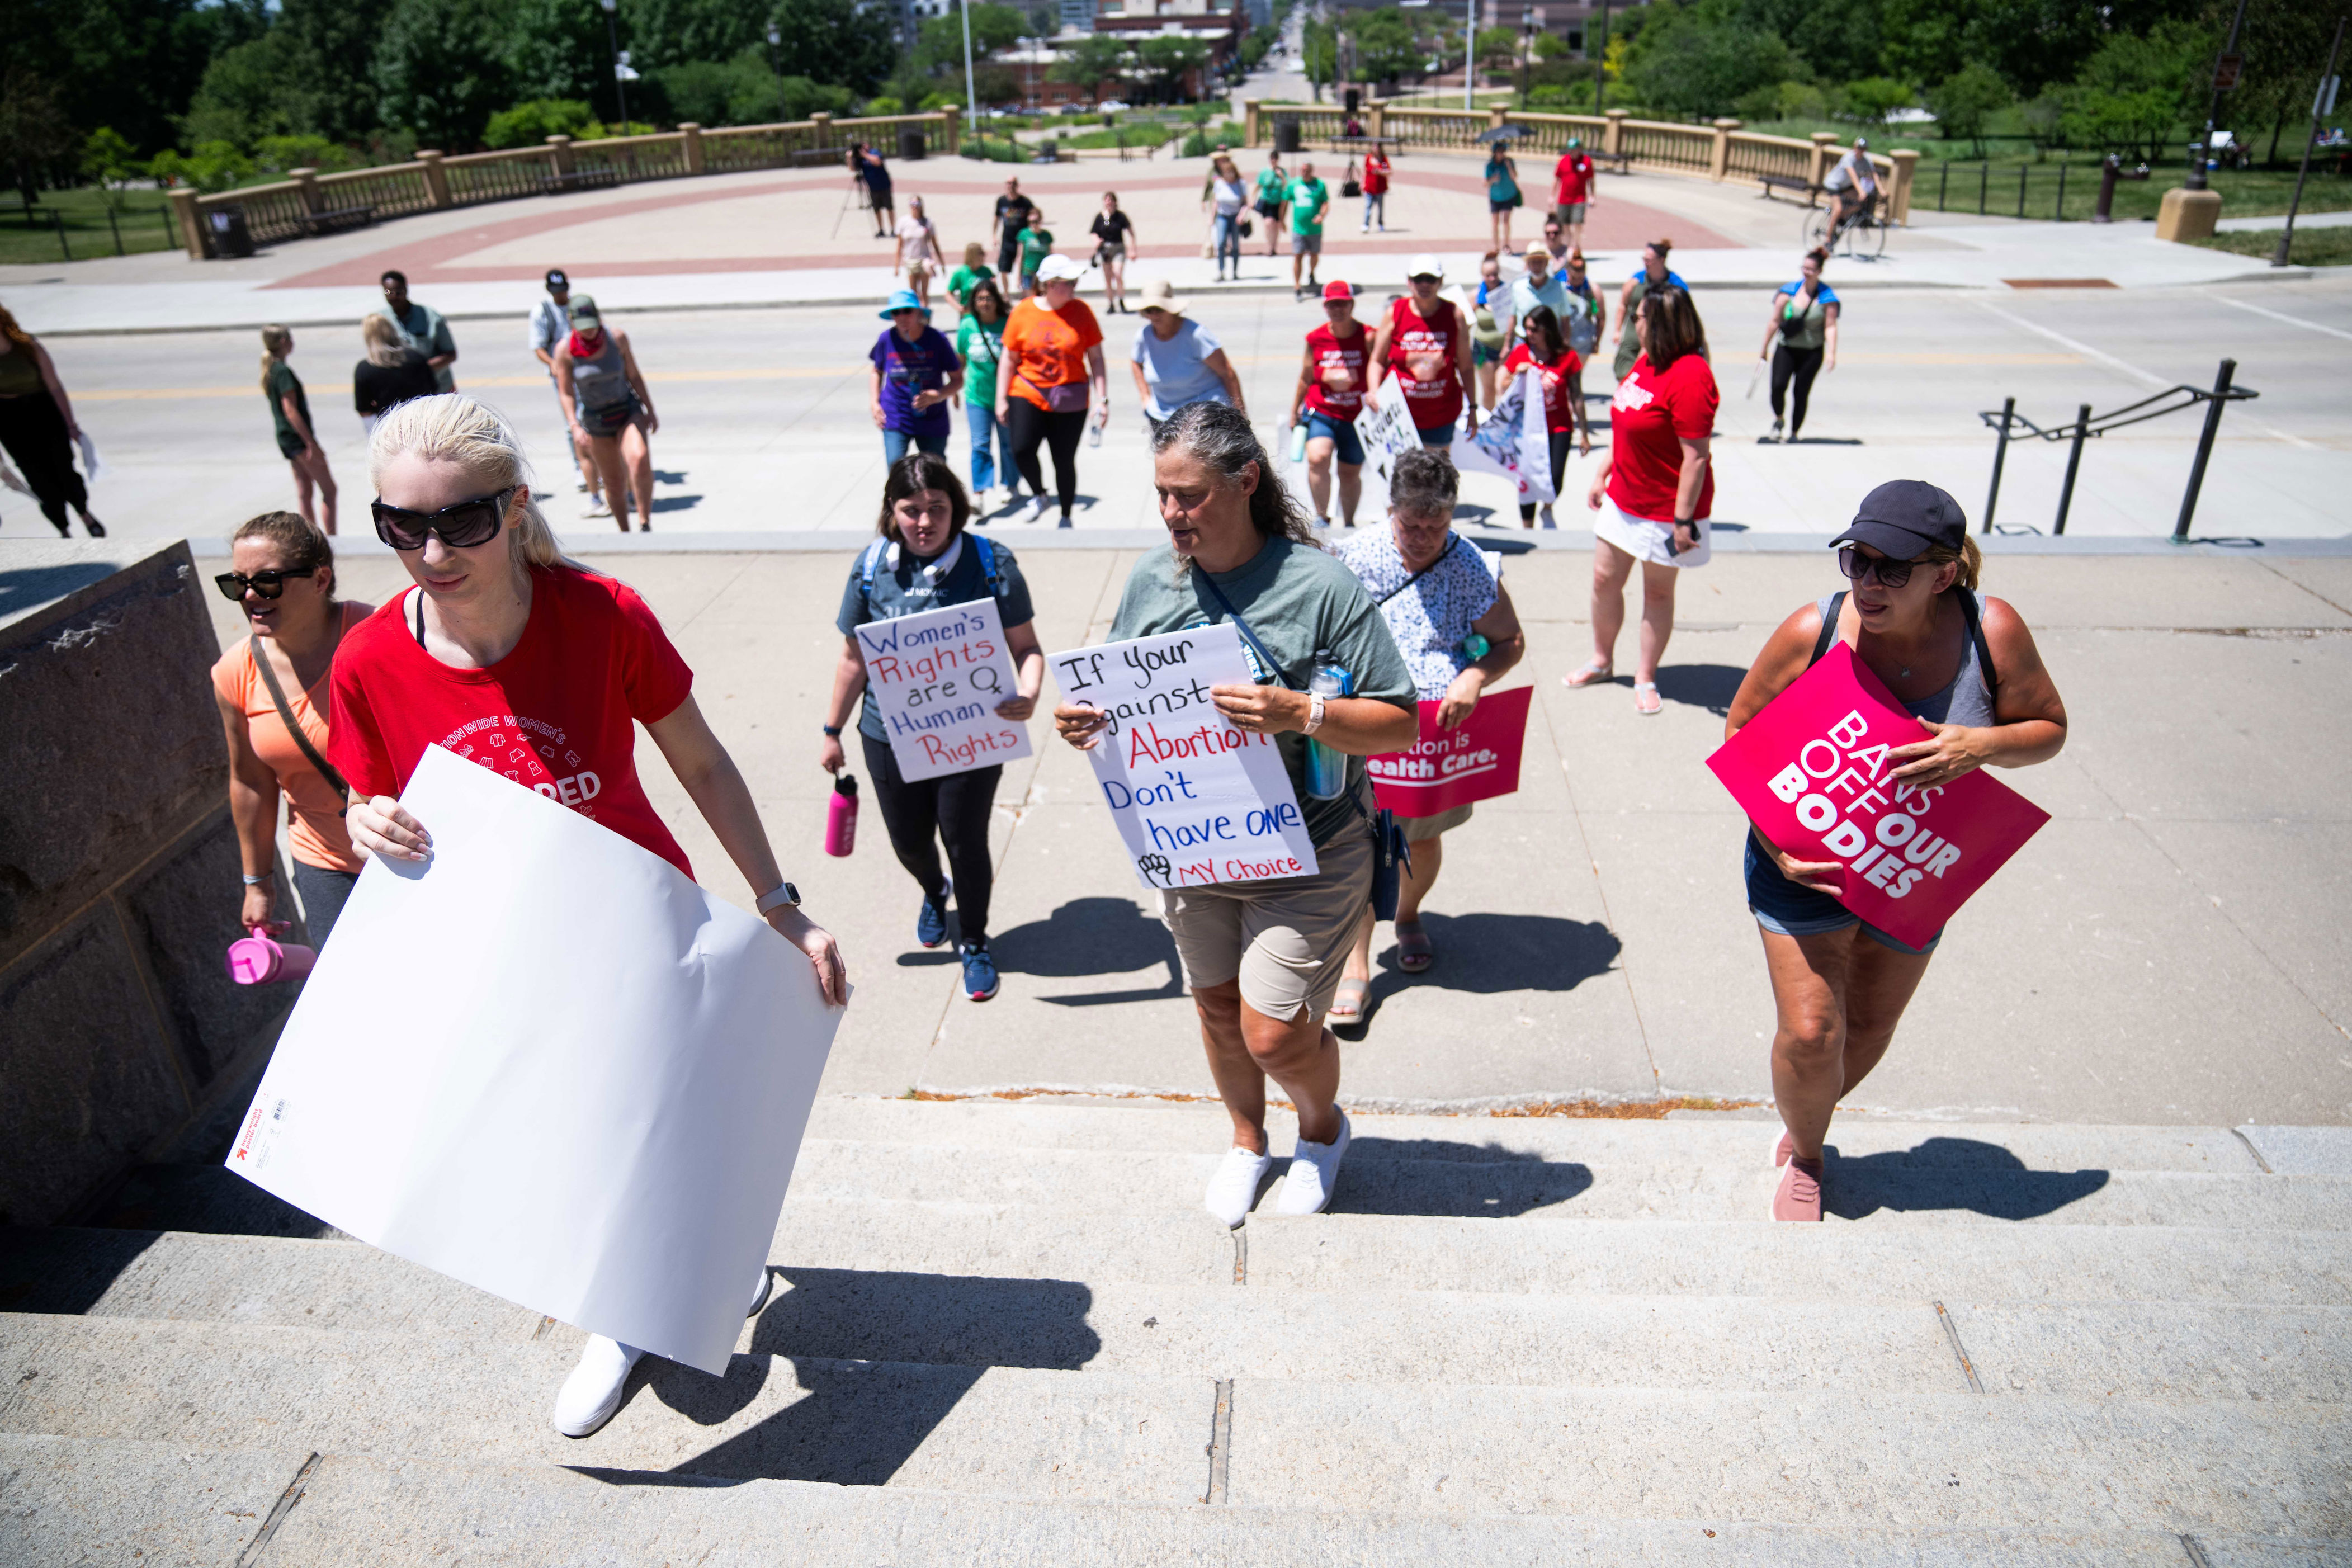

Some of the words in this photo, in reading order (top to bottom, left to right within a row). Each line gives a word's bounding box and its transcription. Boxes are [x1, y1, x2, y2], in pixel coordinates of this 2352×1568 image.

[861, 612, 985, 654] Women's
[869, 640, 995, 684] Rights
[1060, 653, 1104, 692] If
[1243, 644, 1263, 679] VIBES
[907, 681, 957, 708] are
[504, 715, 566, 744] WOMEN'S
[891, 702, 984, 736] Human
[915, 729, 1017, 767] Rights
[1455, 730, 1470, 749] is
[1103, 771, 1198, 810] Don't
[1800, 739, 1889, 815] OFF
[1874, 812, 1961, 879] OUR
[1146, 815, 1236, 851] have
[1767, 761, 1923, 899] BODIES
[1179, 858, 1218, 885] MY
[240, 1108, 258, 1146] heavyweight
[246, 1129, 255, 1149] poster
[253, 1109, 263, 1128] board
